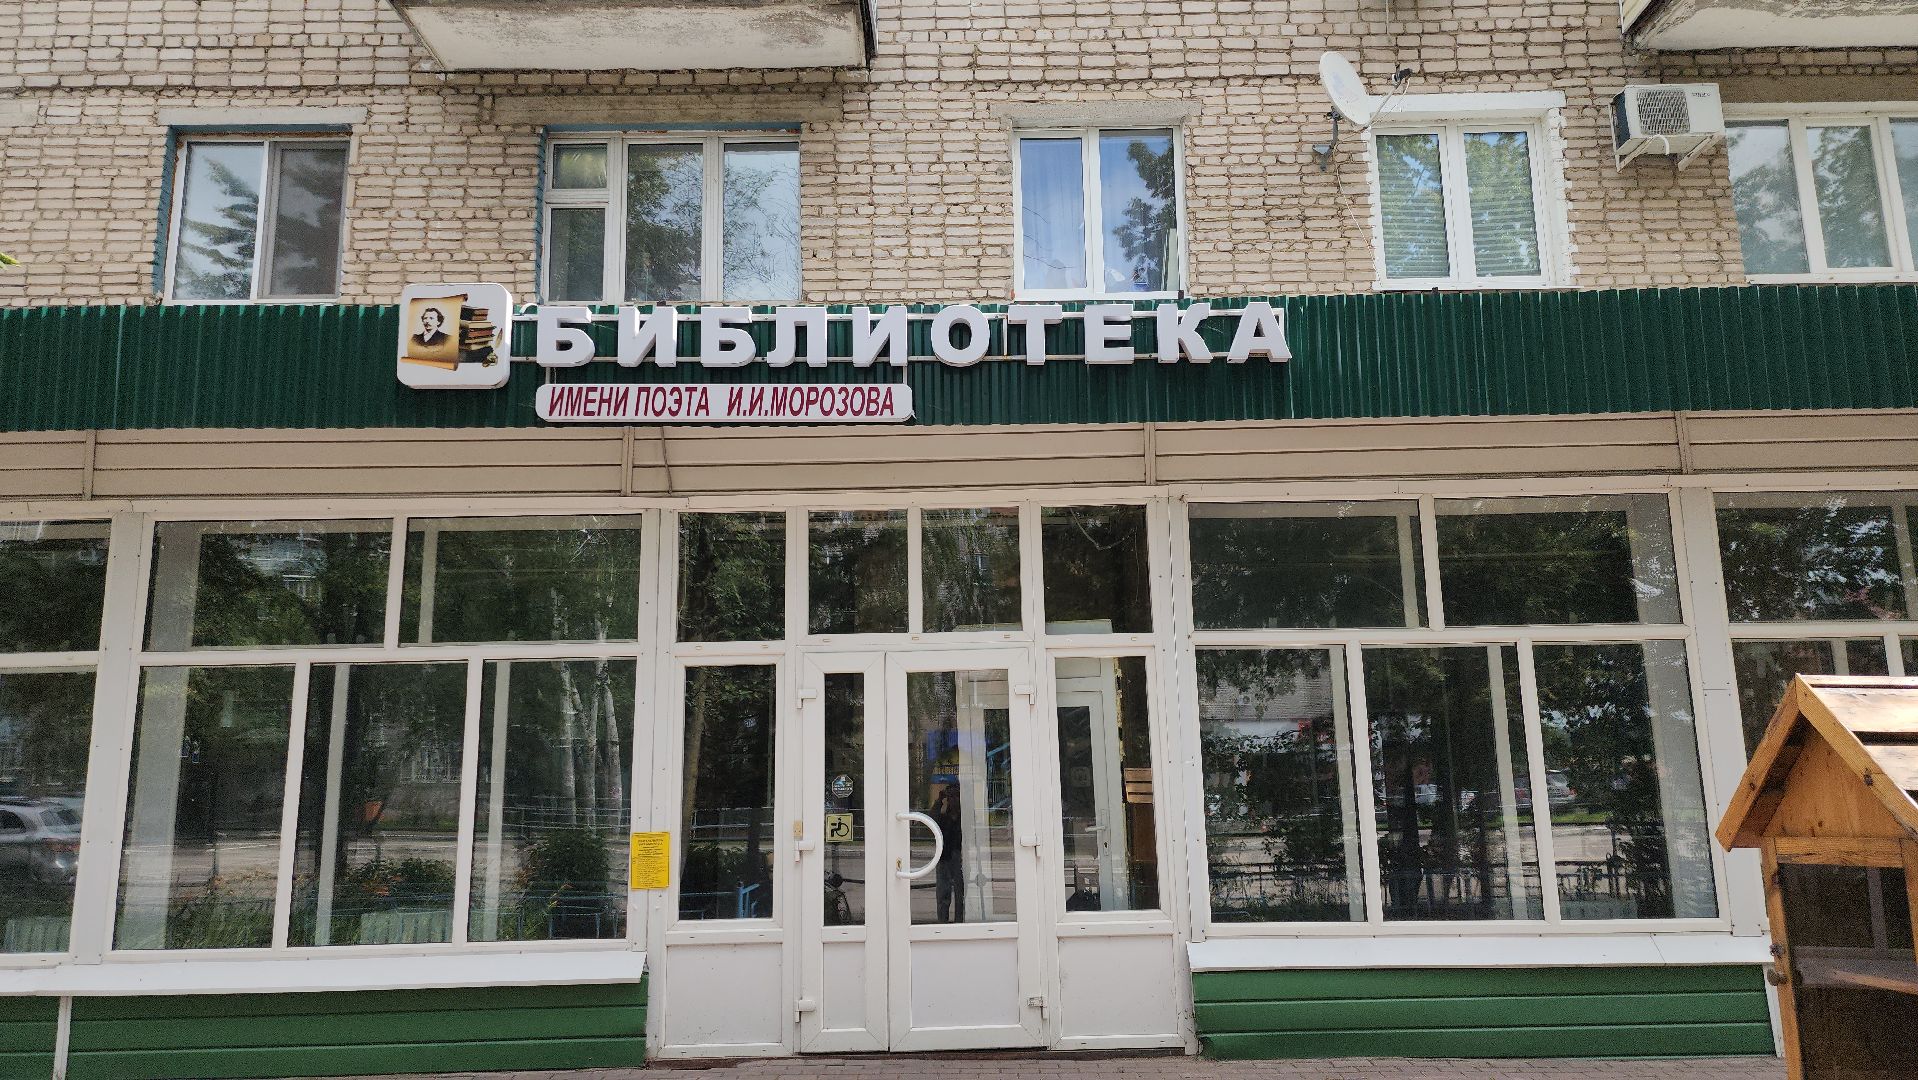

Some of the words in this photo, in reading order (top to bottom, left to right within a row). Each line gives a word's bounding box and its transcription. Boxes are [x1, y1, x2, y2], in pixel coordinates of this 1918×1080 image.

[536, 301, 1292, 368] БИБЛИОТЕКА
[548, 386, 630, 417] ИМЕНИ
[634, 386, 710, 417] ПОЭТА
[727, 386, 895, 417] И.И.МОРОЗОВА
